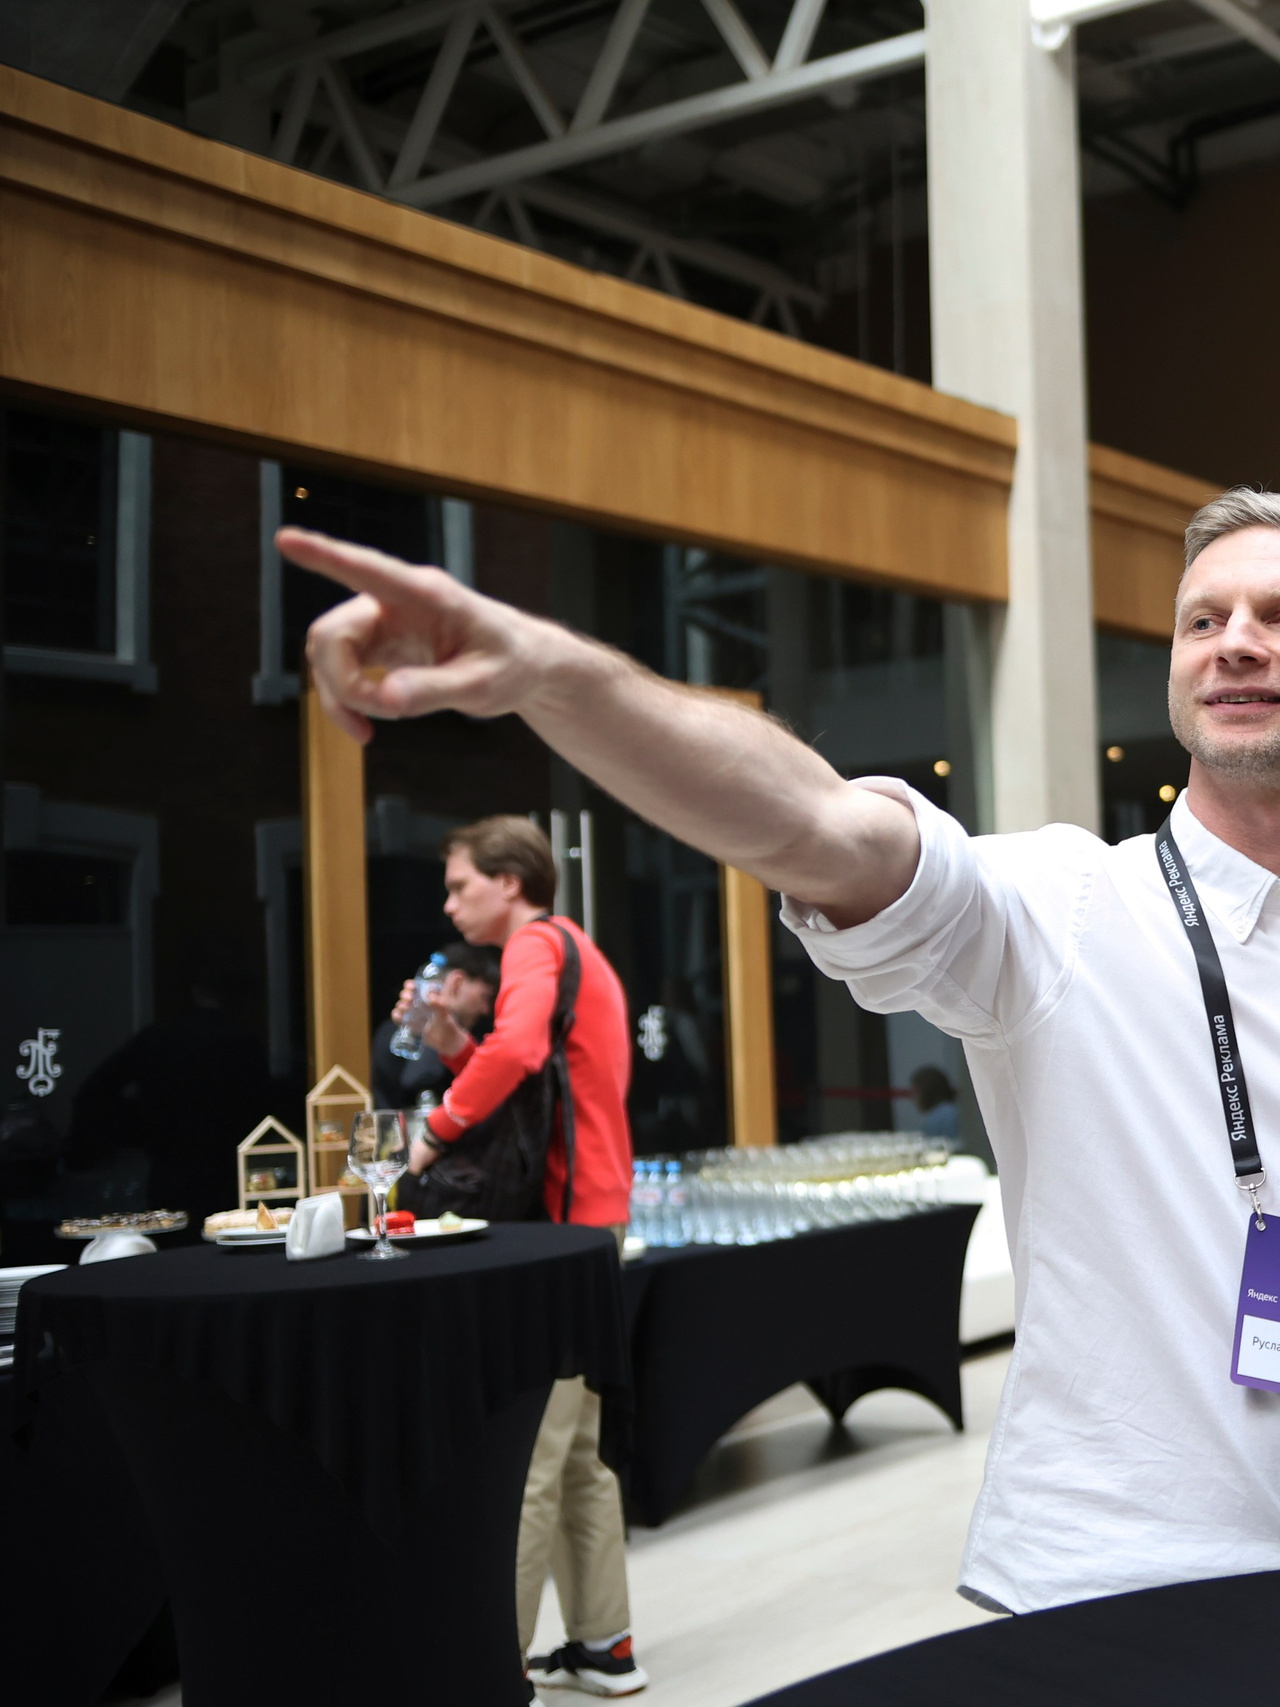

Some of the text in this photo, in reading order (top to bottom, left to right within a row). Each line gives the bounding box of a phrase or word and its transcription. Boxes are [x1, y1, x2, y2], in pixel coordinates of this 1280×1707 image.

[1159, 840, 1200, 927] Яндекс Реклама
[1213, 1014, 1247, 1141] Яндекс Реклама
[1247, 1288, 1279, 1304] Яндекс
